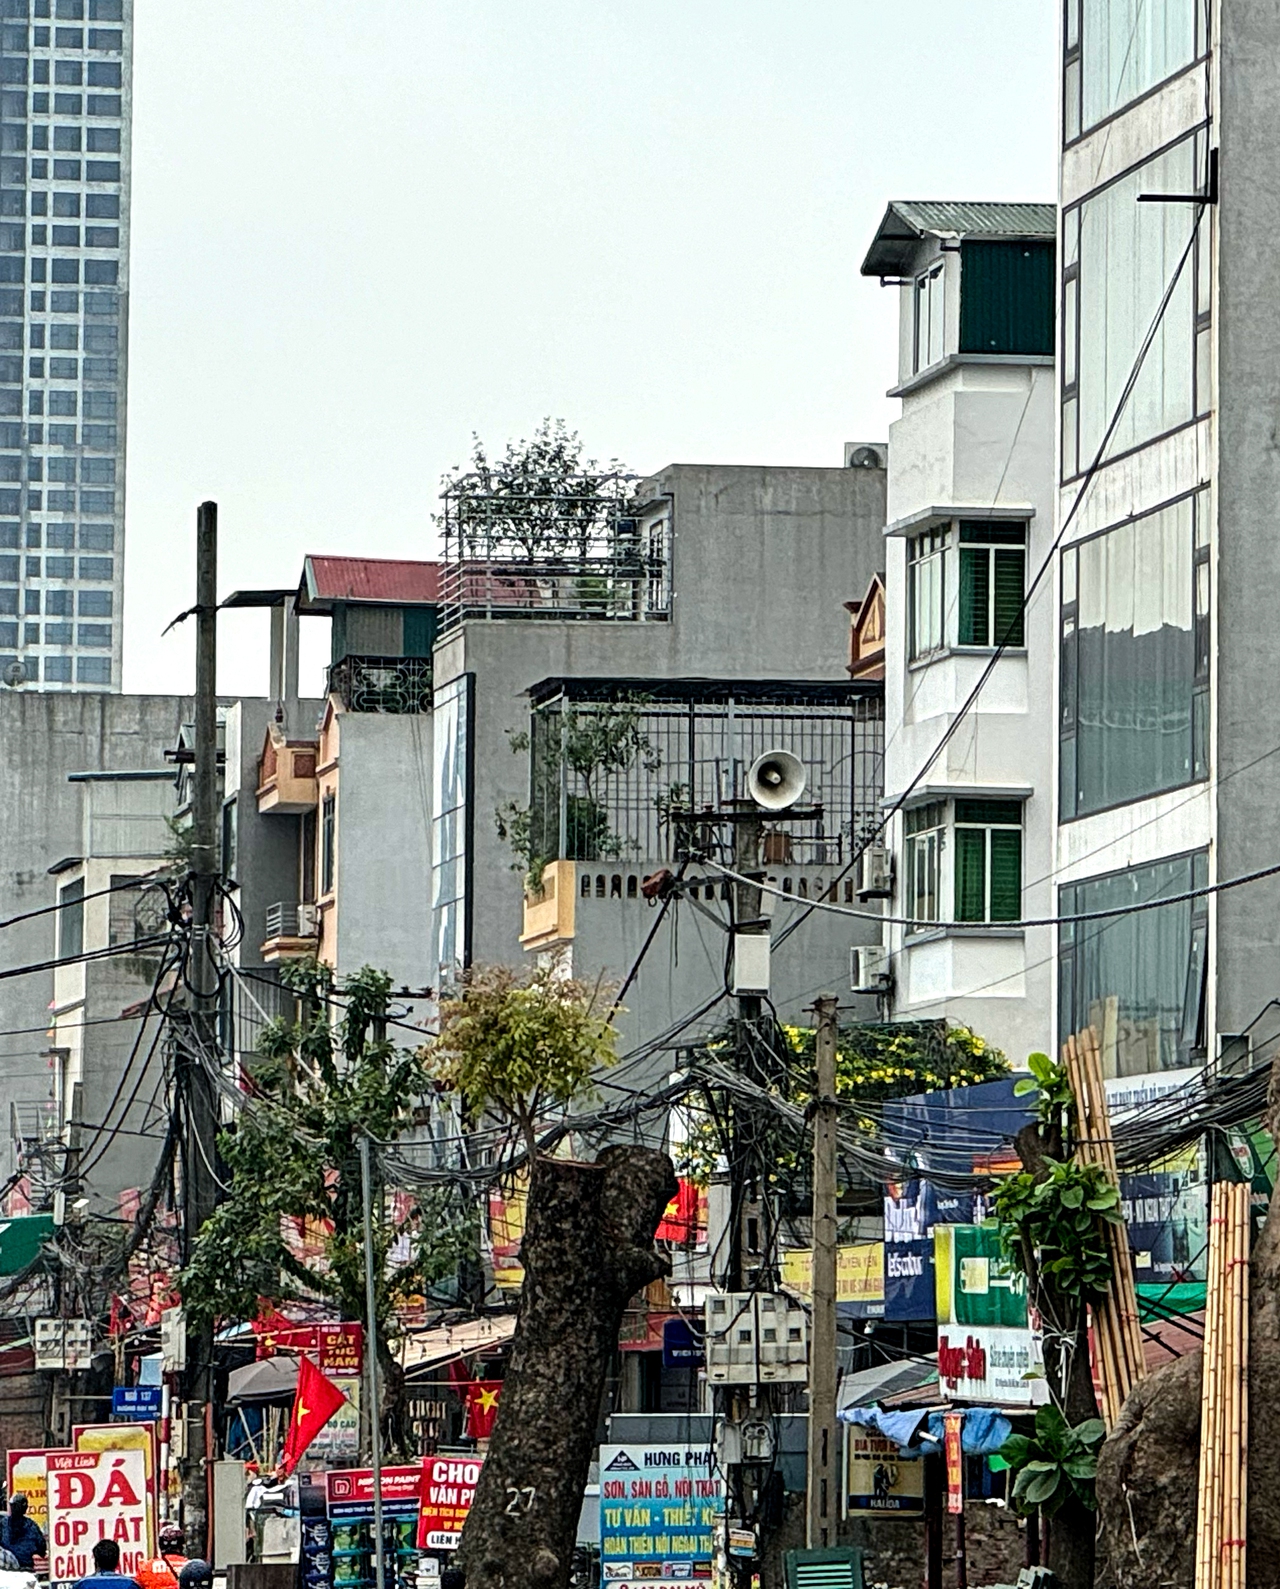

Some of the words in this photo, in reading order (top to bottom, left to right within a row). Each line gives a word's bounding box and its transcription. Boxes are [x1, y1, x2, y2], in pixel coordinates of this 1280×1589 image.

[323, 1357, 359, 1367] NAM
[54, 1457, 73, 1468] Việt
[75, 1455, 96, 1468] Linh
[644, 1451, 681, 1466] HƯNG
[432, 1462, 480, 1484] CHO
[54, 1459, 142, 1510] ĐÁ
[429, 1484, 458, 1505] VĂN
[604, 1479, 628, 1500] SƠN,
[505, 1486, 536, 1516] 27
[604, 1507, 622, 1528] TƯ
[624, 1504, 651, 1527] VẤN
[54, 1512, 89, 1547] ỐP
[431, 1534, 453, 1545] LIÊN
[54, 1549, 87, 1579] CẦU
